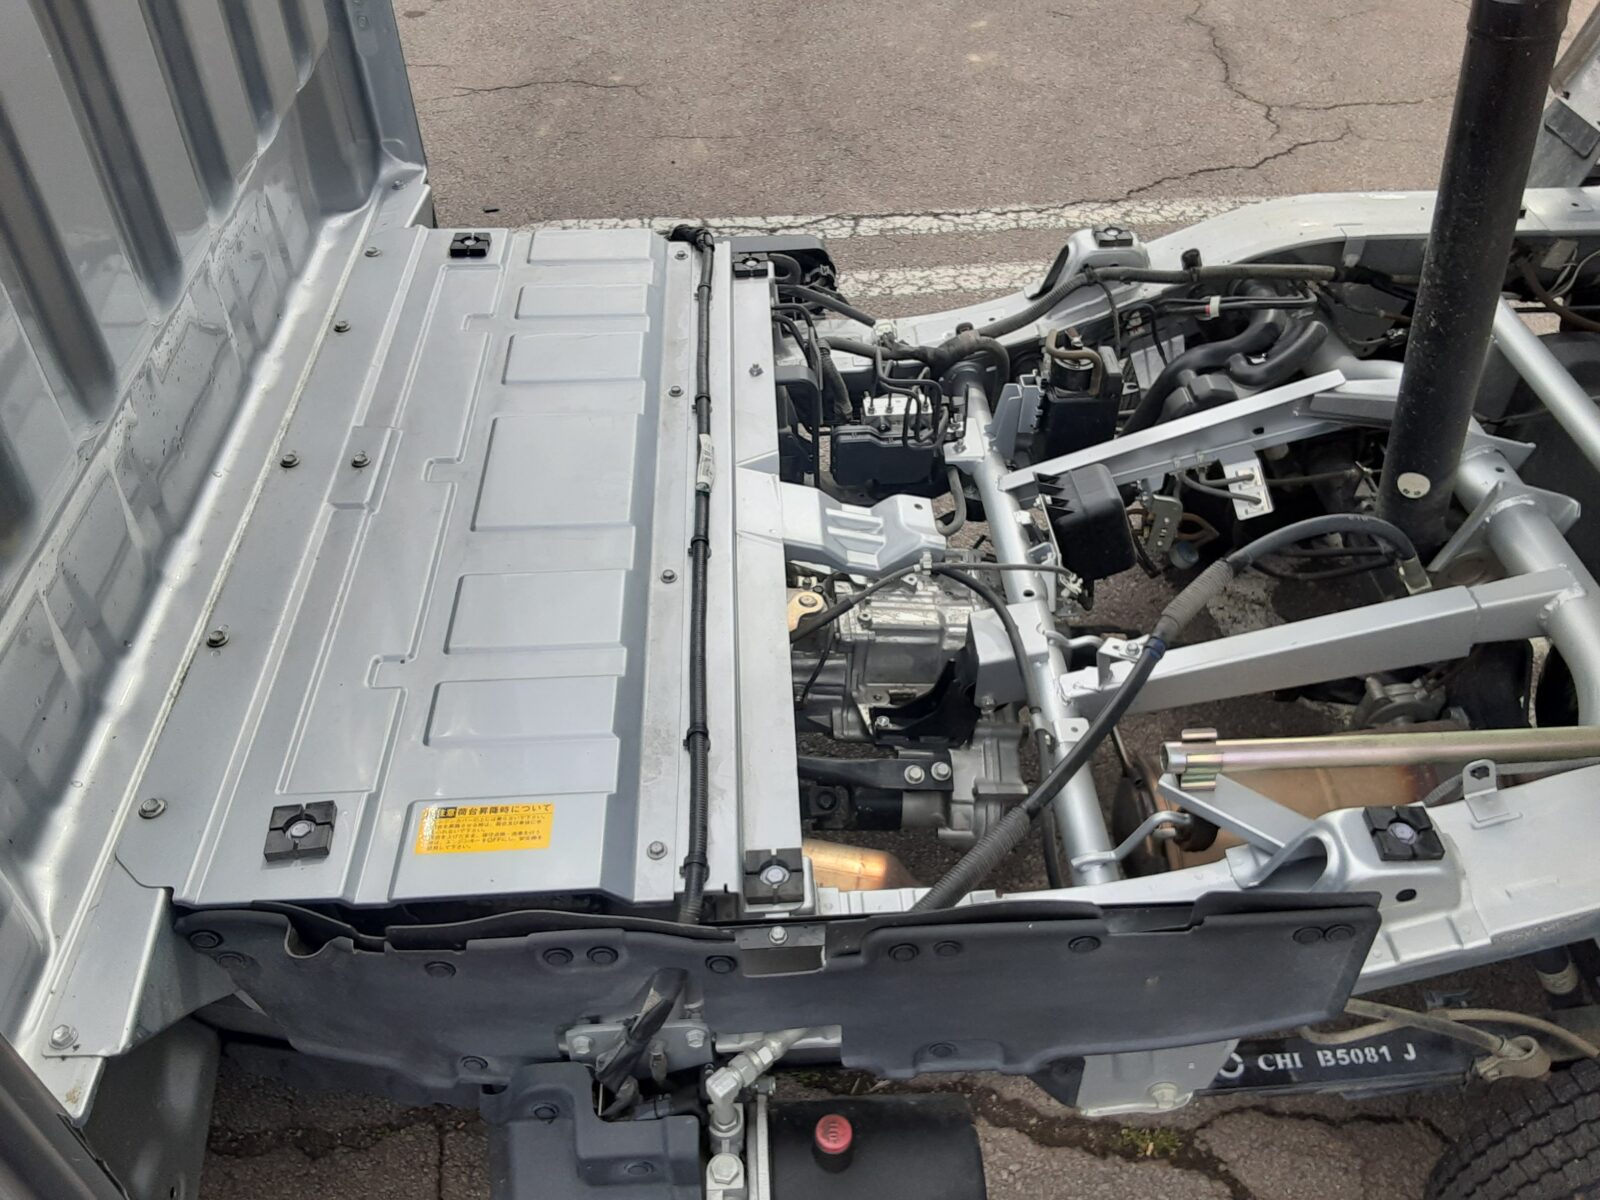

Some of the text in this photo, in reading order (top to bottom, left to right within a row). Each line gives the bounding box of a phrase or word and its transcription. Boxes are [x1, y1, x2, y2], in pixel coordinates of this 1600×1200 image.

[458, 804, 551, 815] 荷台昇降時について
[1257, 1042, 1417, 1071] CHI B5081 J
